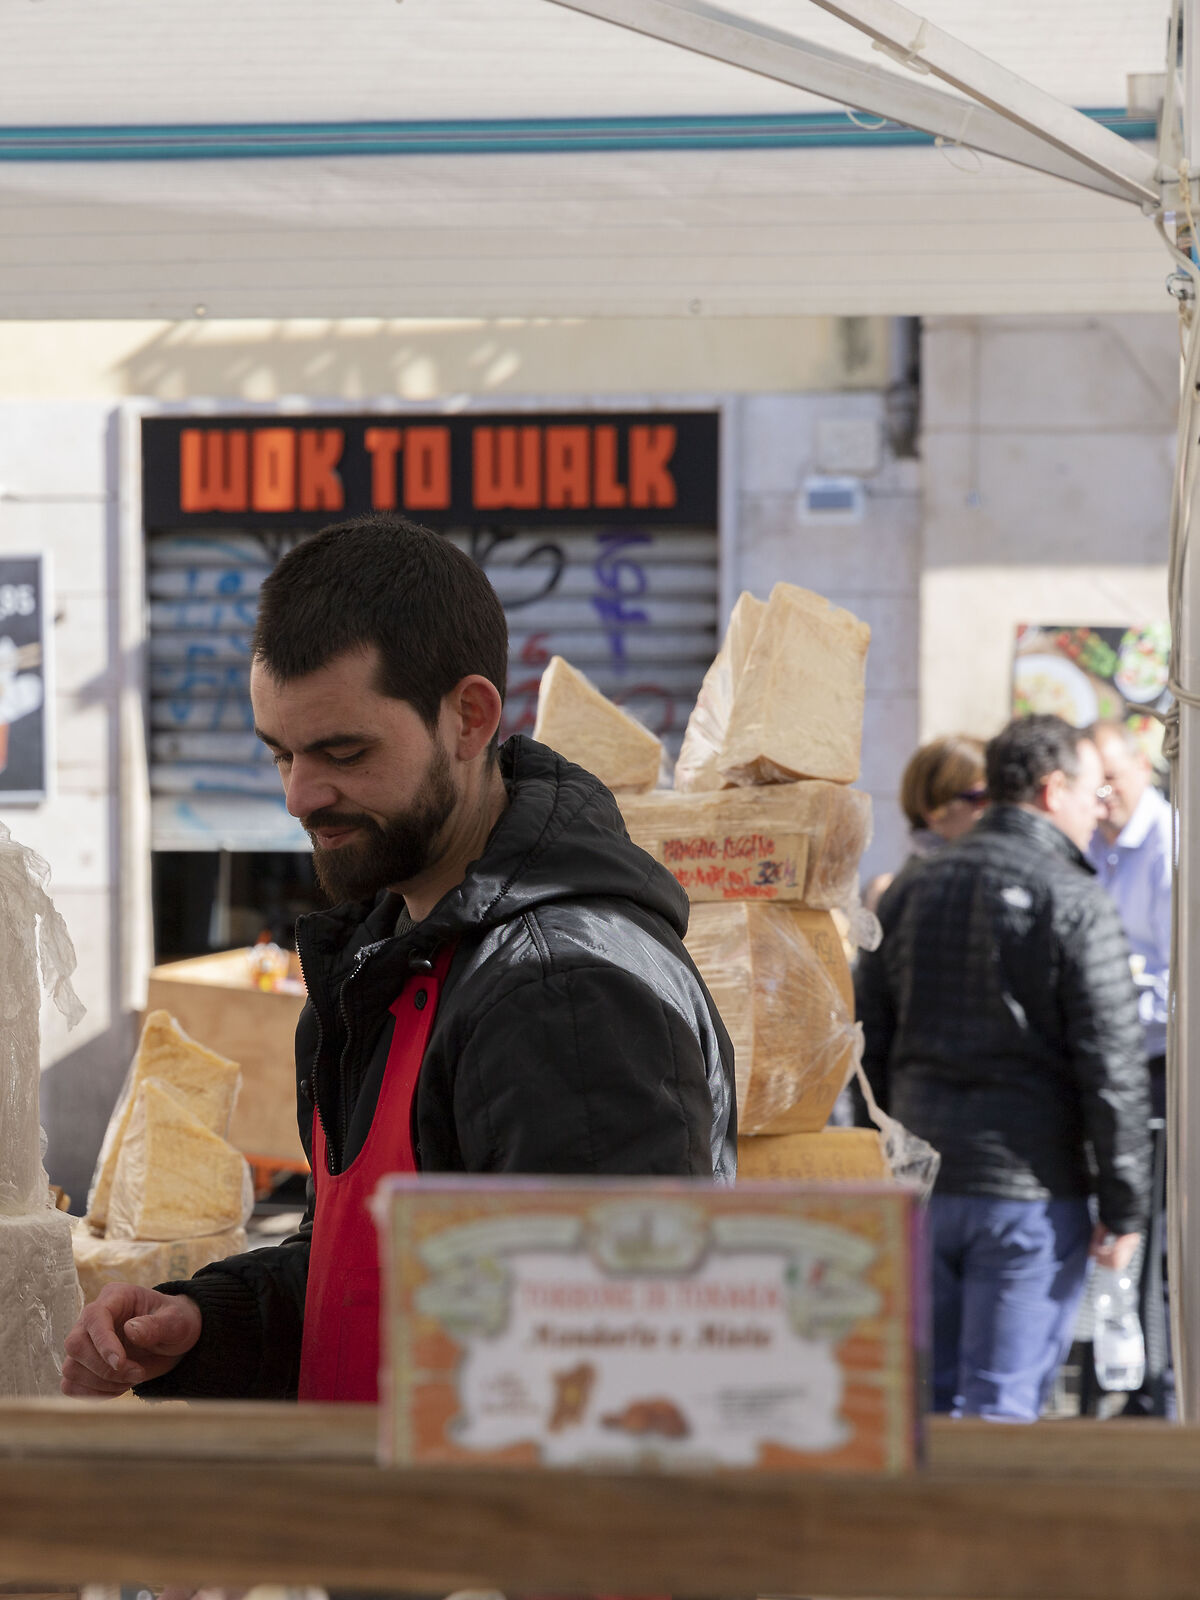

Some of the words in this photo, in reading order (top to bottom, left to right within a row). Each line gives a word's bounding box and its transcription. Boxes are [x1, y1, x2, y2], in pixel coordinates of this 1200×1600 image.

[180, 427, 345, 512] WOK
[364, 426, 451, 510] TO
[473, 425, 677, 509] WALK
